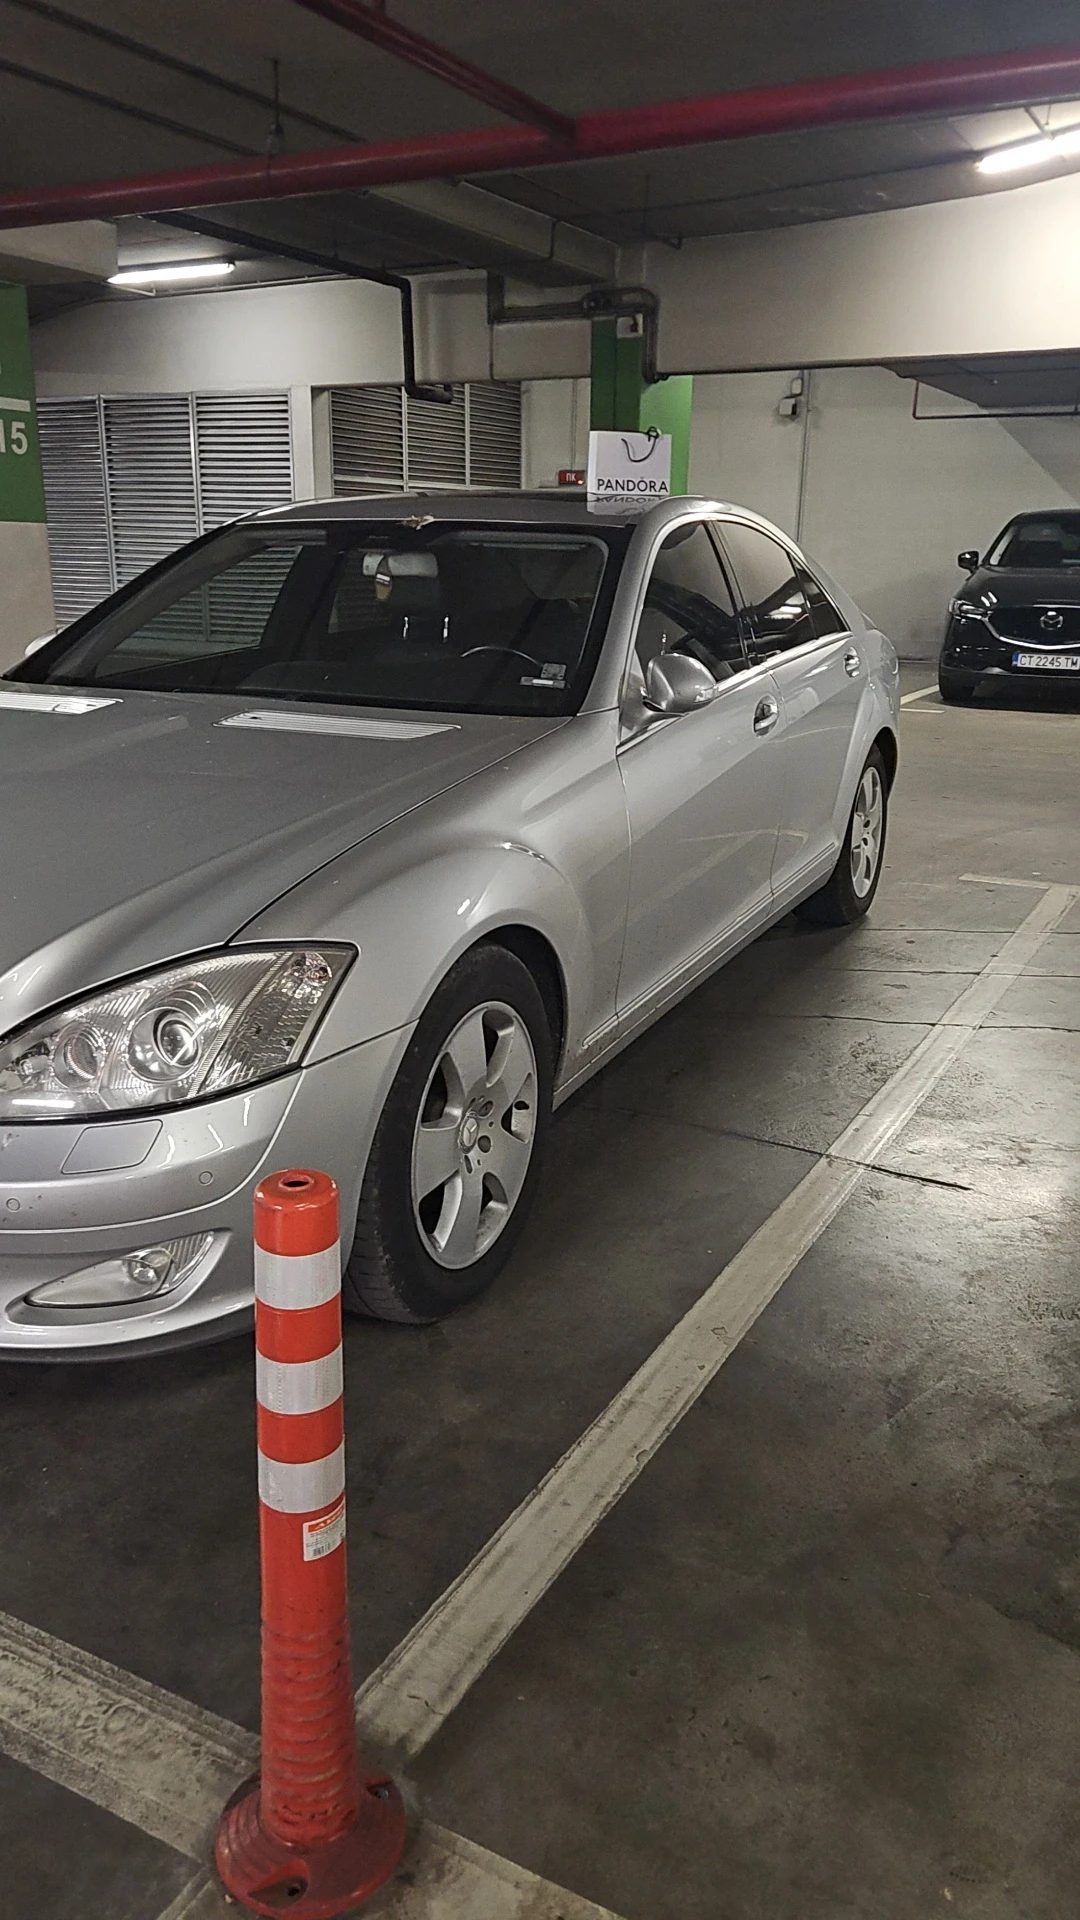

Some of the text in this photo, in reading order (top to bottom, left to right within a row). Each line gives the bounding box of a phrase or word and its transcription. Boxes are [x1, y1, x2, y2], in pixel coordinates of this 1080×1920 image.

[597, 478, 669, 492] PANDORA
[1020, 655, 1078, 668] CT 2245 TM
